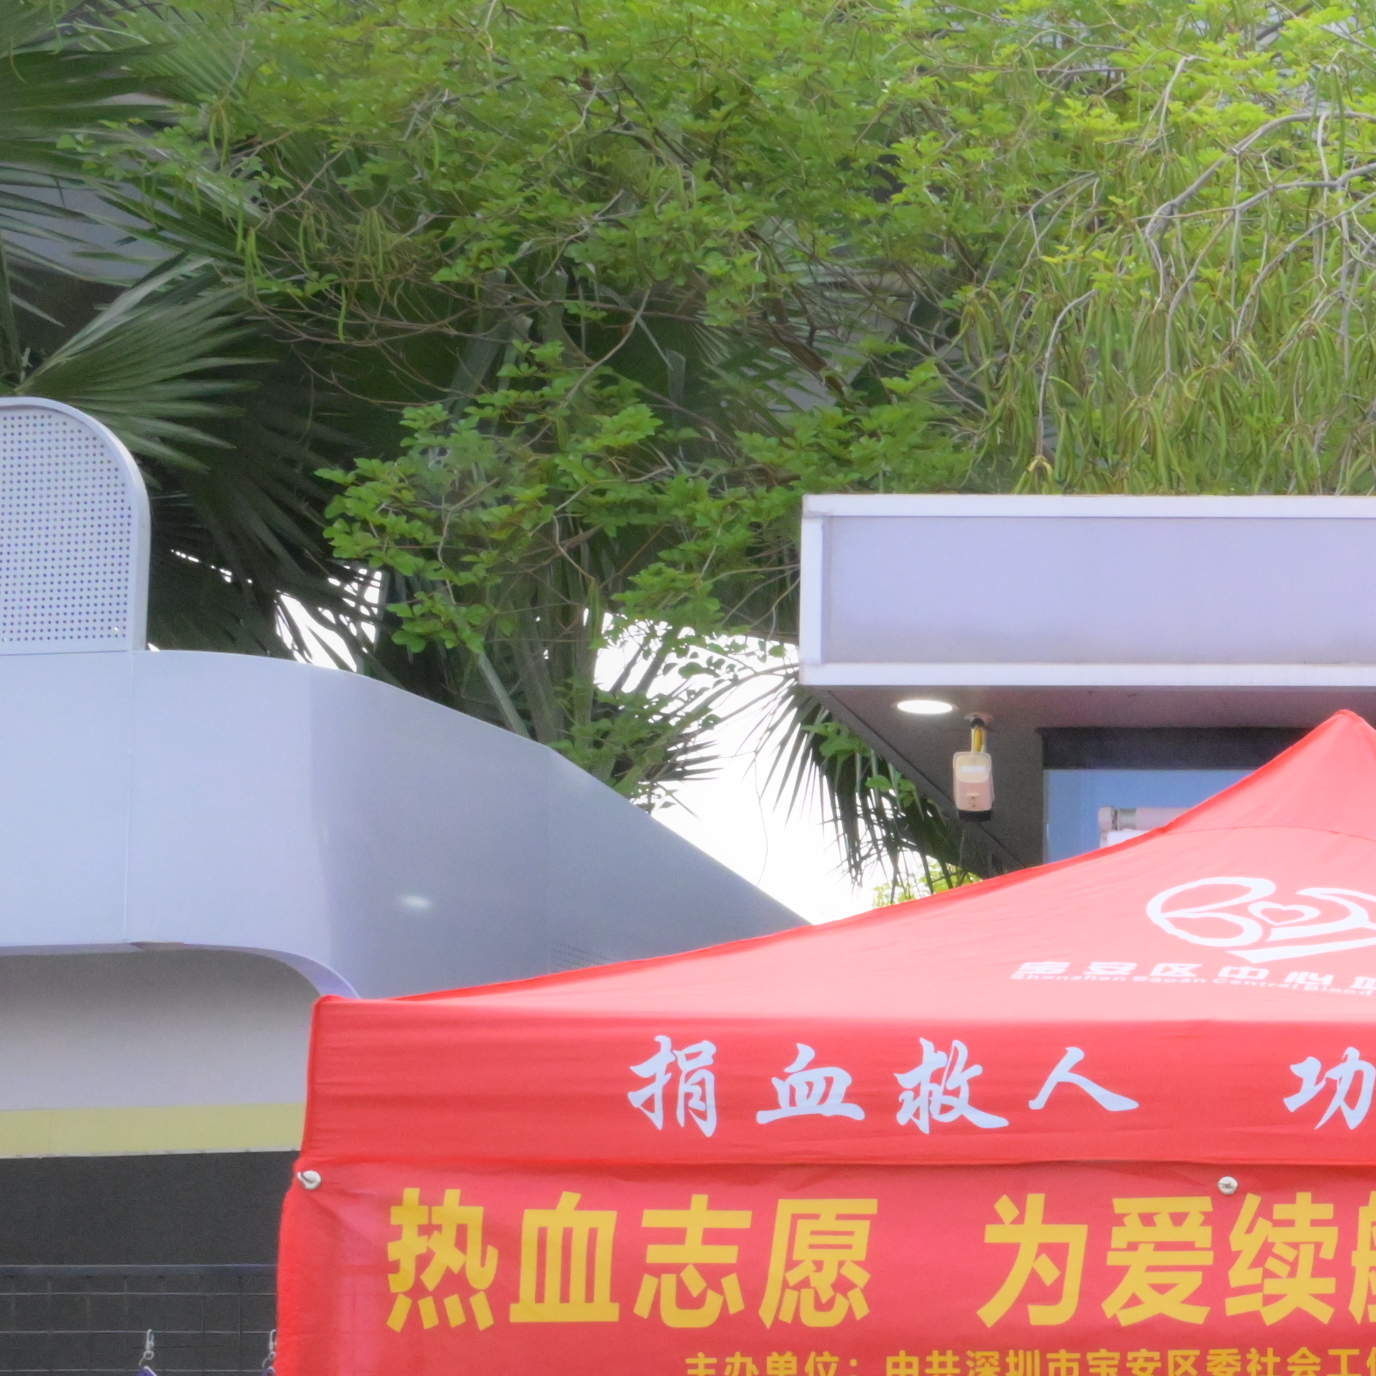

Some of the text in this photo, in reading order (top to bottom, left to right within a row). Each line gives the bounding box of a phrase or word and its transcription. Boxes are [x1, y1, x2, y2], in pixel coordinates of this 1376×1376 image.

[627, 1034, 1139, 1137] 捐血救人
[386, 1187, 879, 1332] 热血志愿
